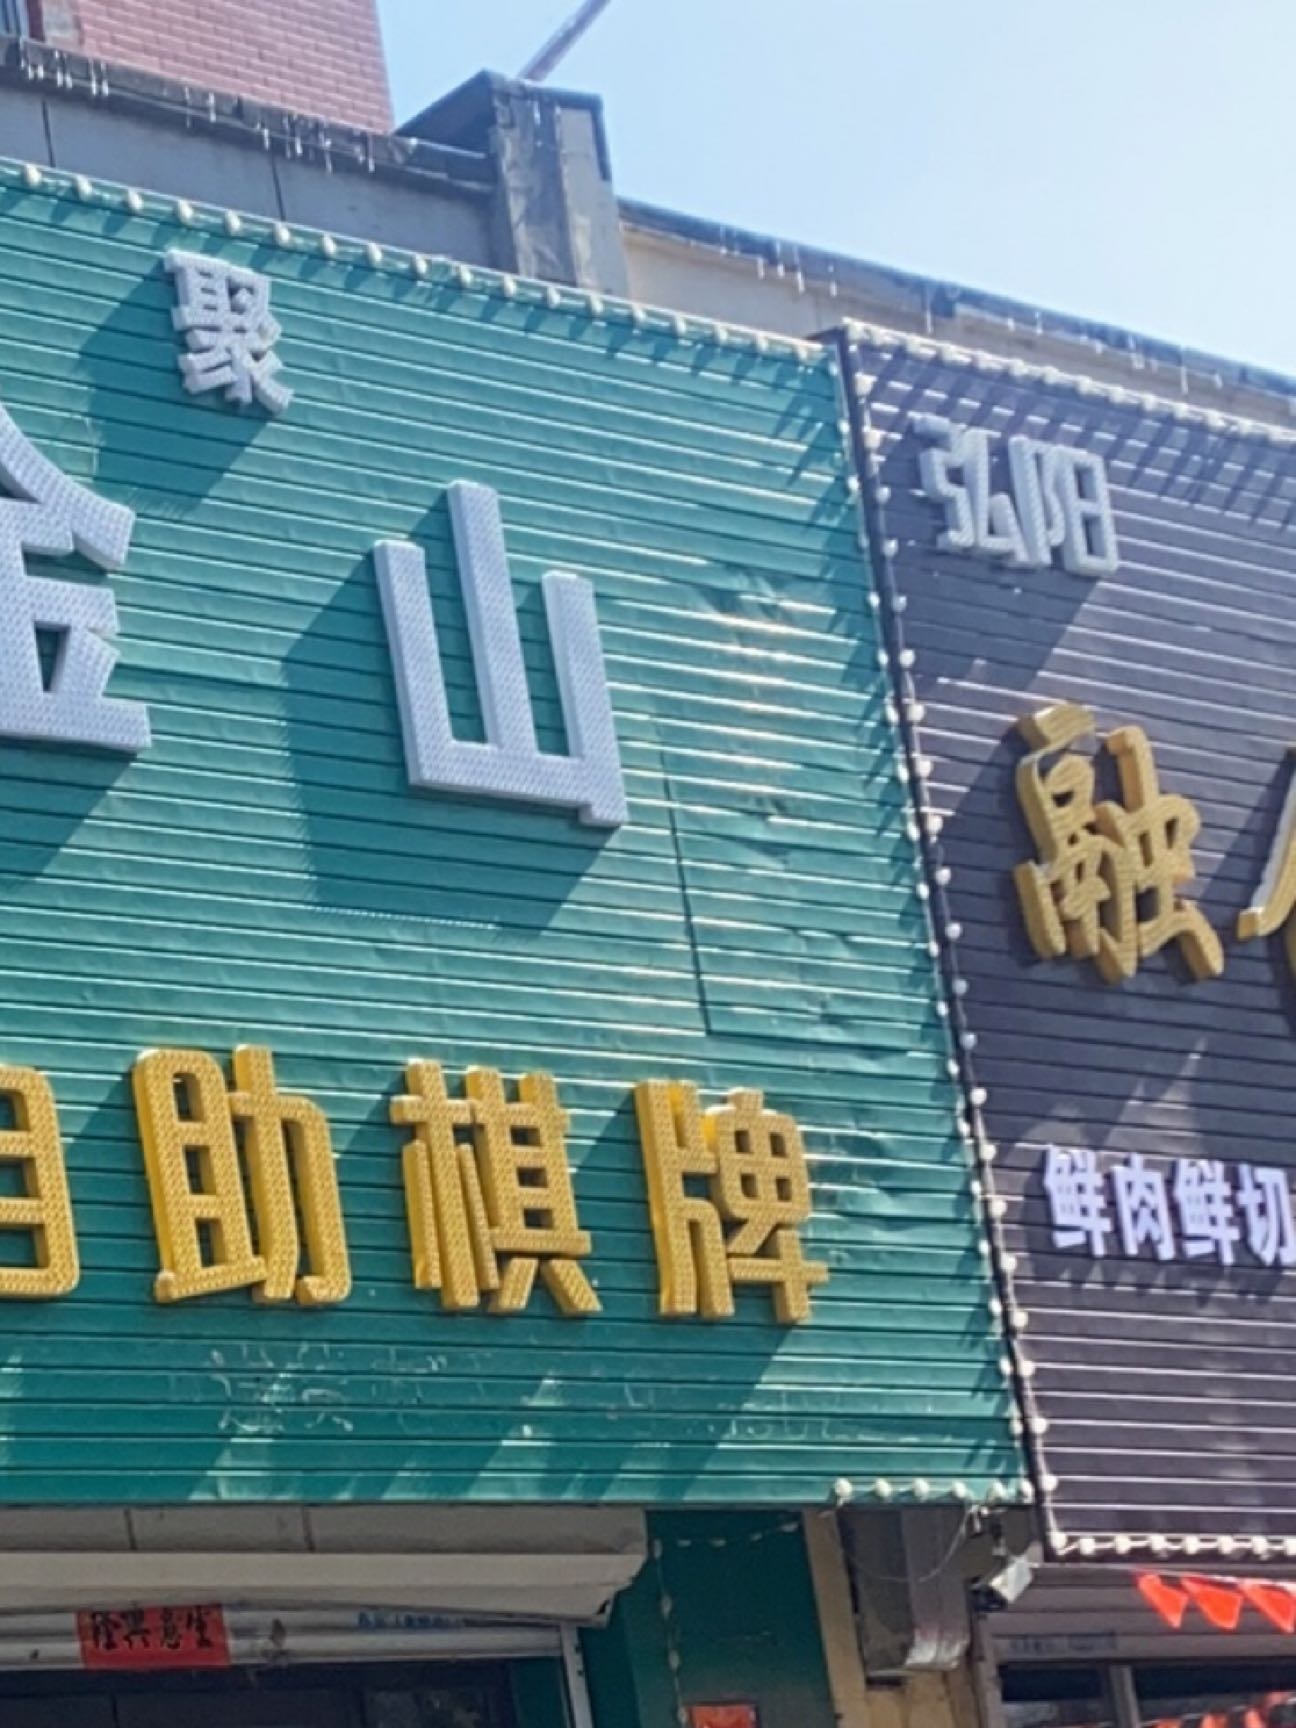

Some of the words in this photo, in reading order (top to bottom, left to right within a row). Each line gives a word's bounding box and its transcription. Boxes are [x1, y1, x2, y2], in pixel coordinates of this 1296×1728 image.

[164, 249, 294, 415] 聚
[911, 411, 1120, 576] 弘阳
[1013, 701, 1296, 985] 融
[1043, 1144, 1296, 1266] 鲜肉鲜切
